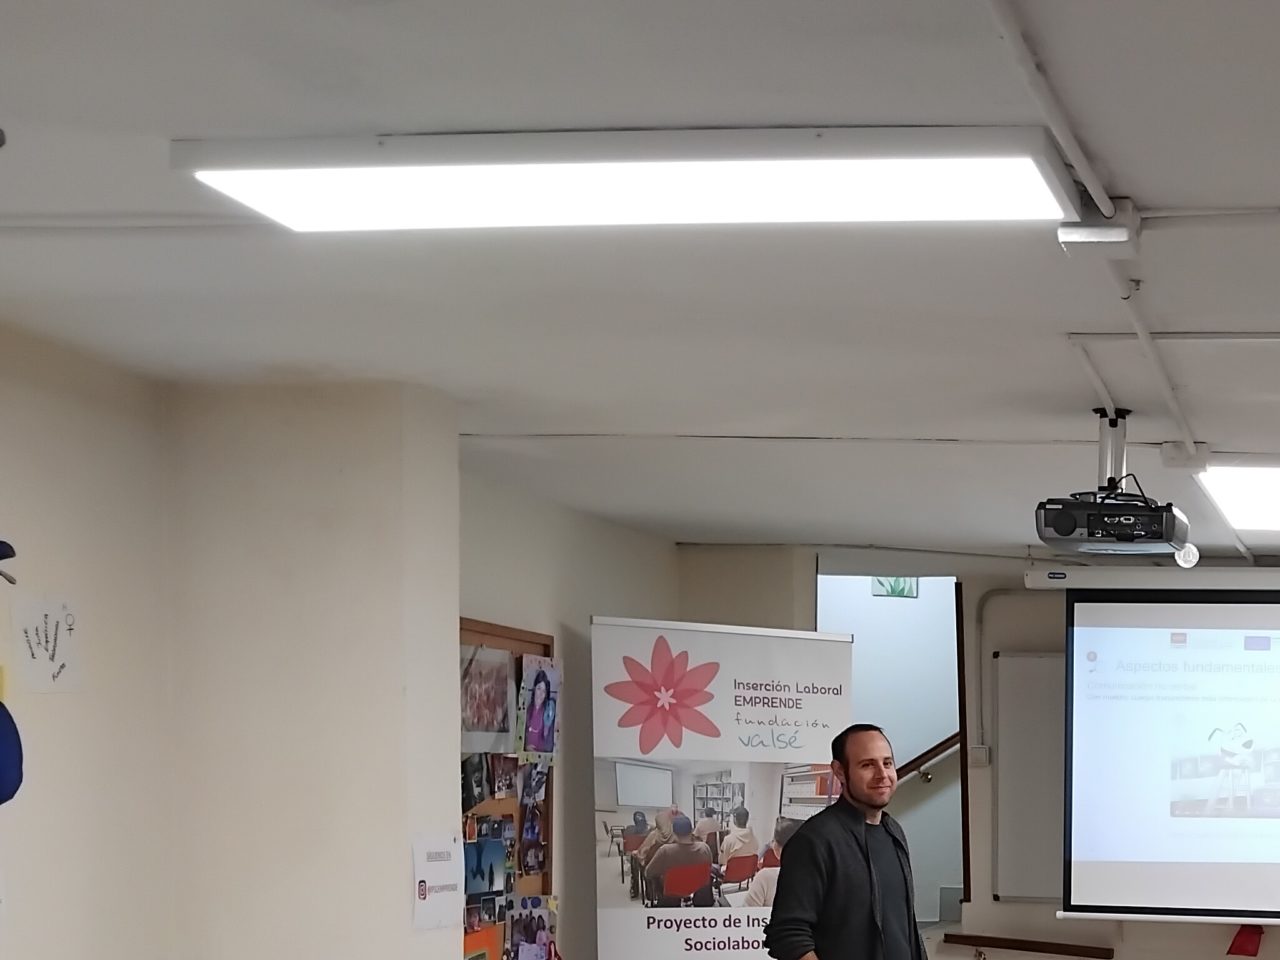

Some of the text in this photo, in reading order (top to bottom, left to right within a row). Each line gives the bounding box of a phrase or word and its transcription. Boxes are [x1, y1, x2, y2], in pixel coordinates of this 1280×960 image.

[733, 678, 842, 696] Inserción Laboral
[734, 695, 803, 710] EMPRENDE
[735, 711, 830, 729] fundación
[738, 730, 806, 749] valsé
[646, 915, 718, 932] Proyecto
[723, 914, 742, 928] de
